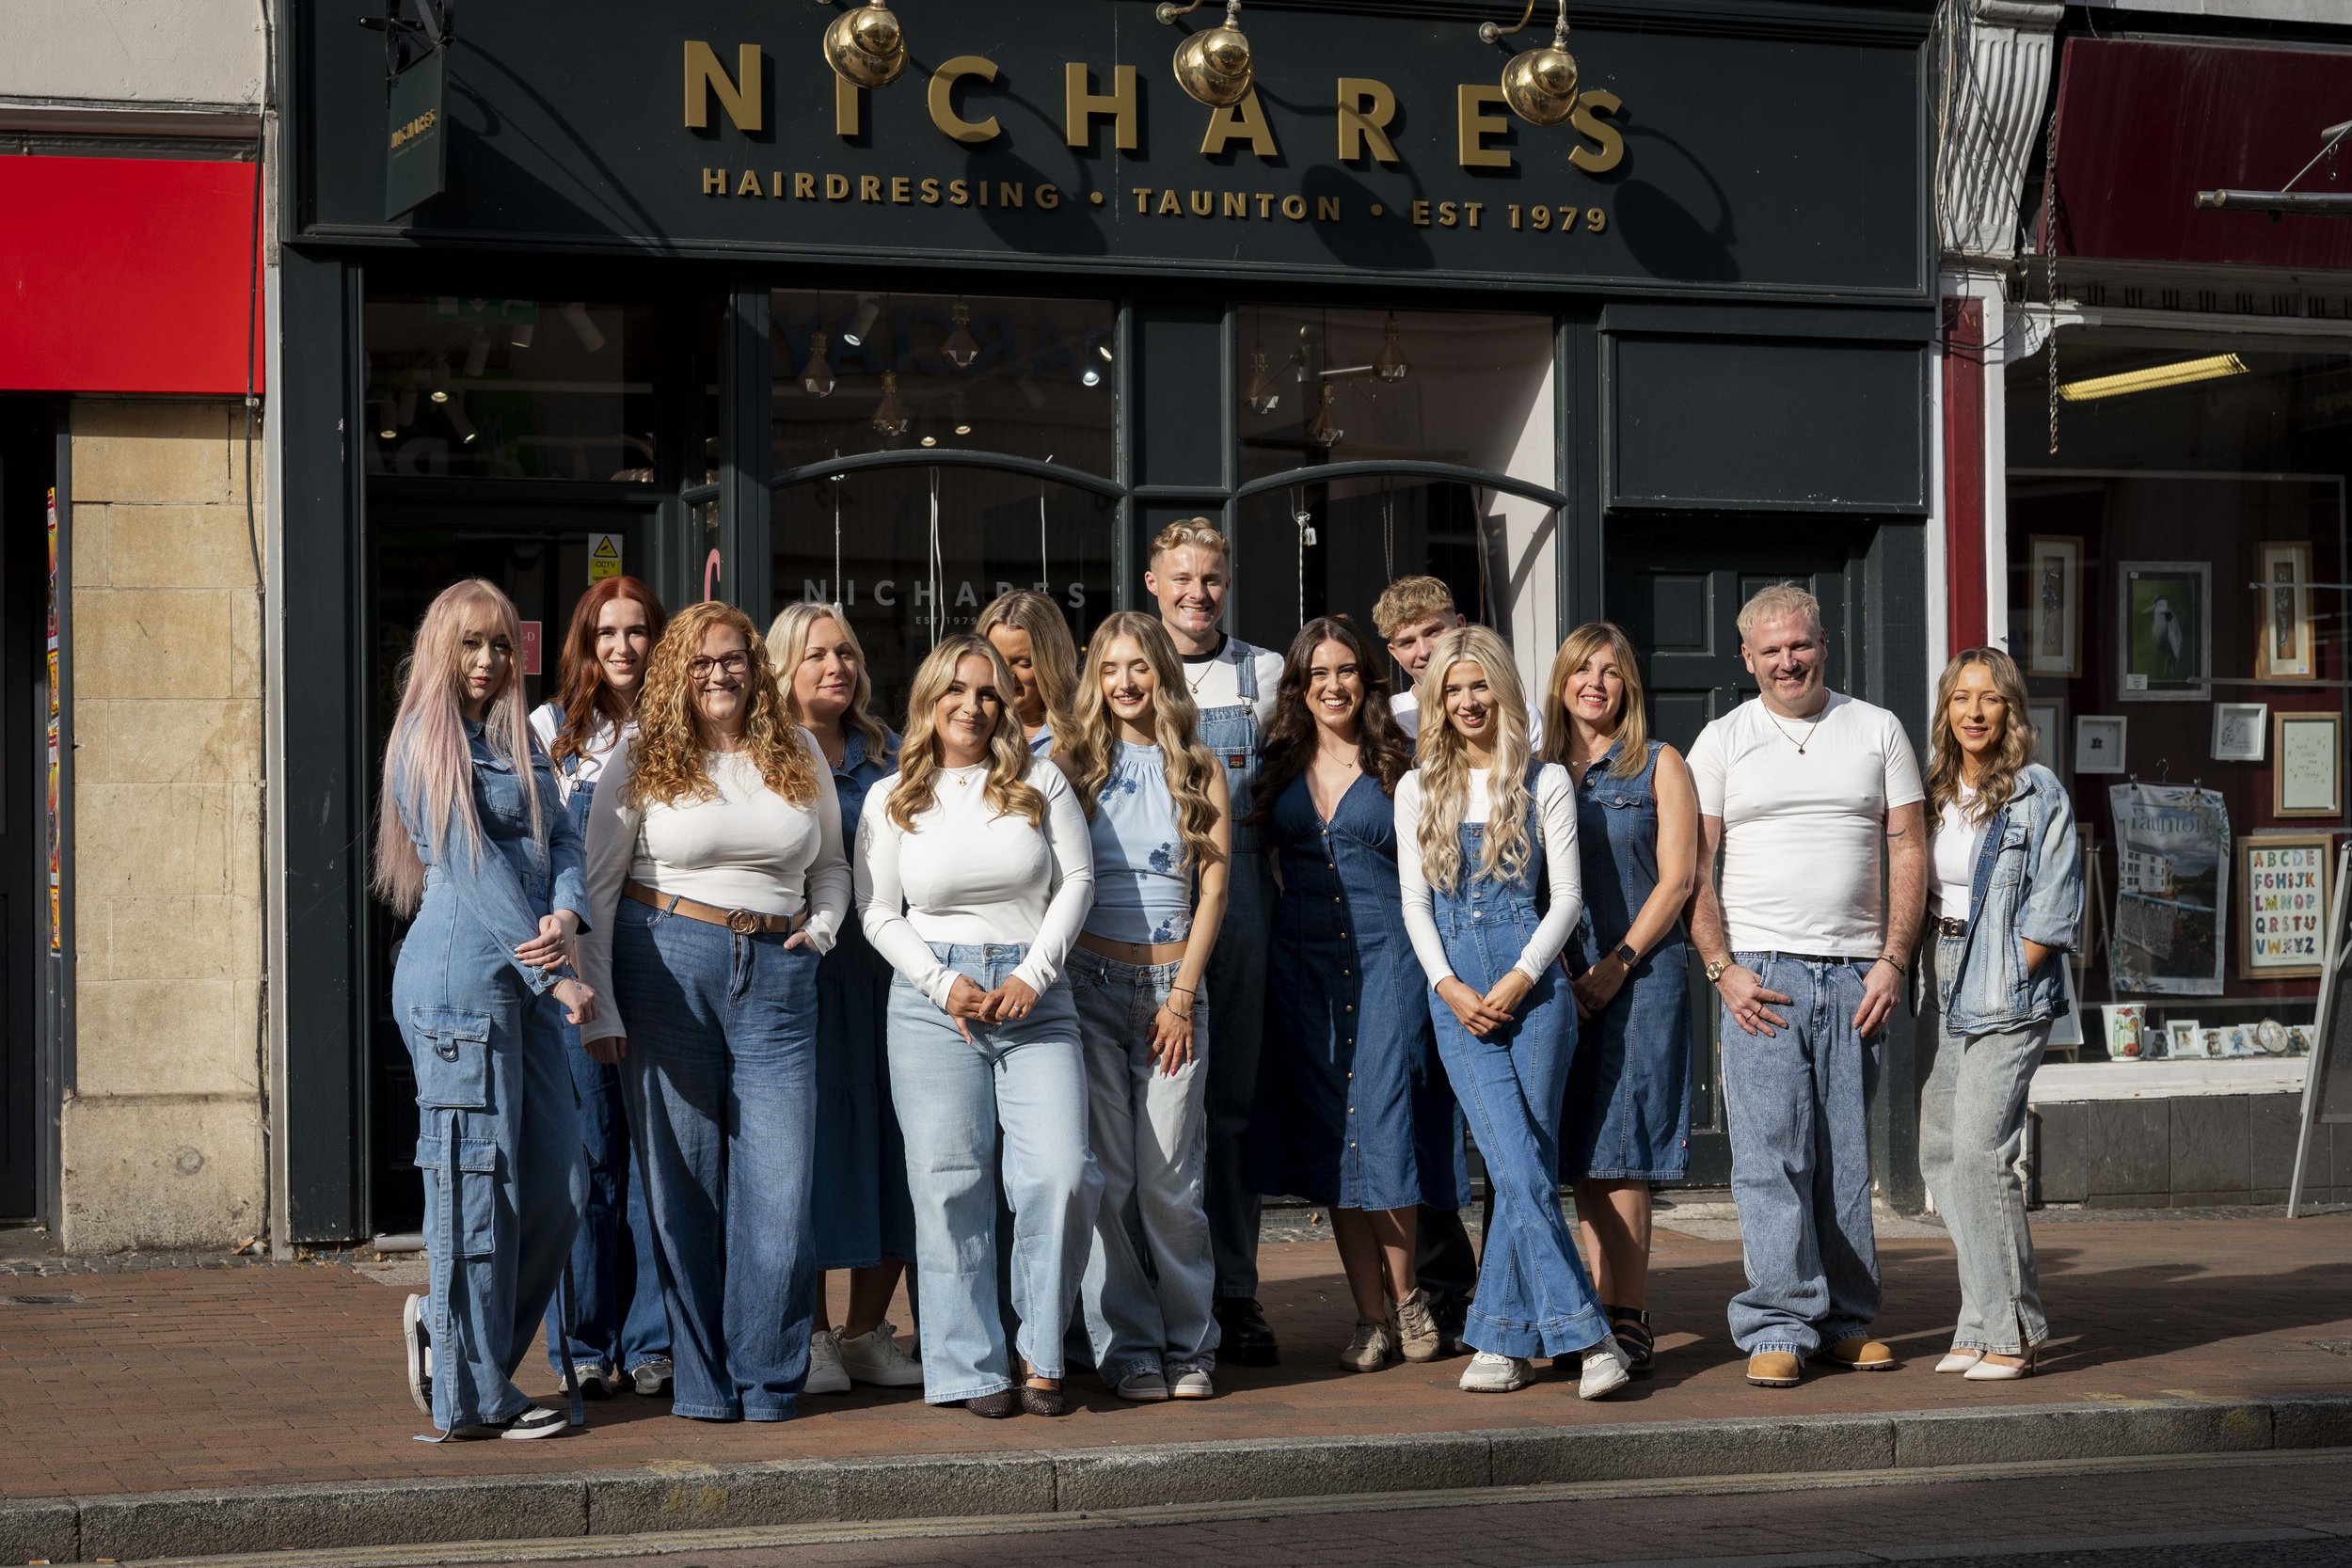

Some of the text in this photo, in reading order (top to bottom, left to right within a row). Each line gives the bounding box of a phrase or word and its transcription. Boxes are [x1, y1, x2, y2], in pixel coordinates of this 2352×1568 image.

[683, 40, 1625, 174] NICHARES
[703, 167, 1608, 232] HAIRDRESSING TAUNTON EST 1979
[915, 616, 977, 626] EST 1979
